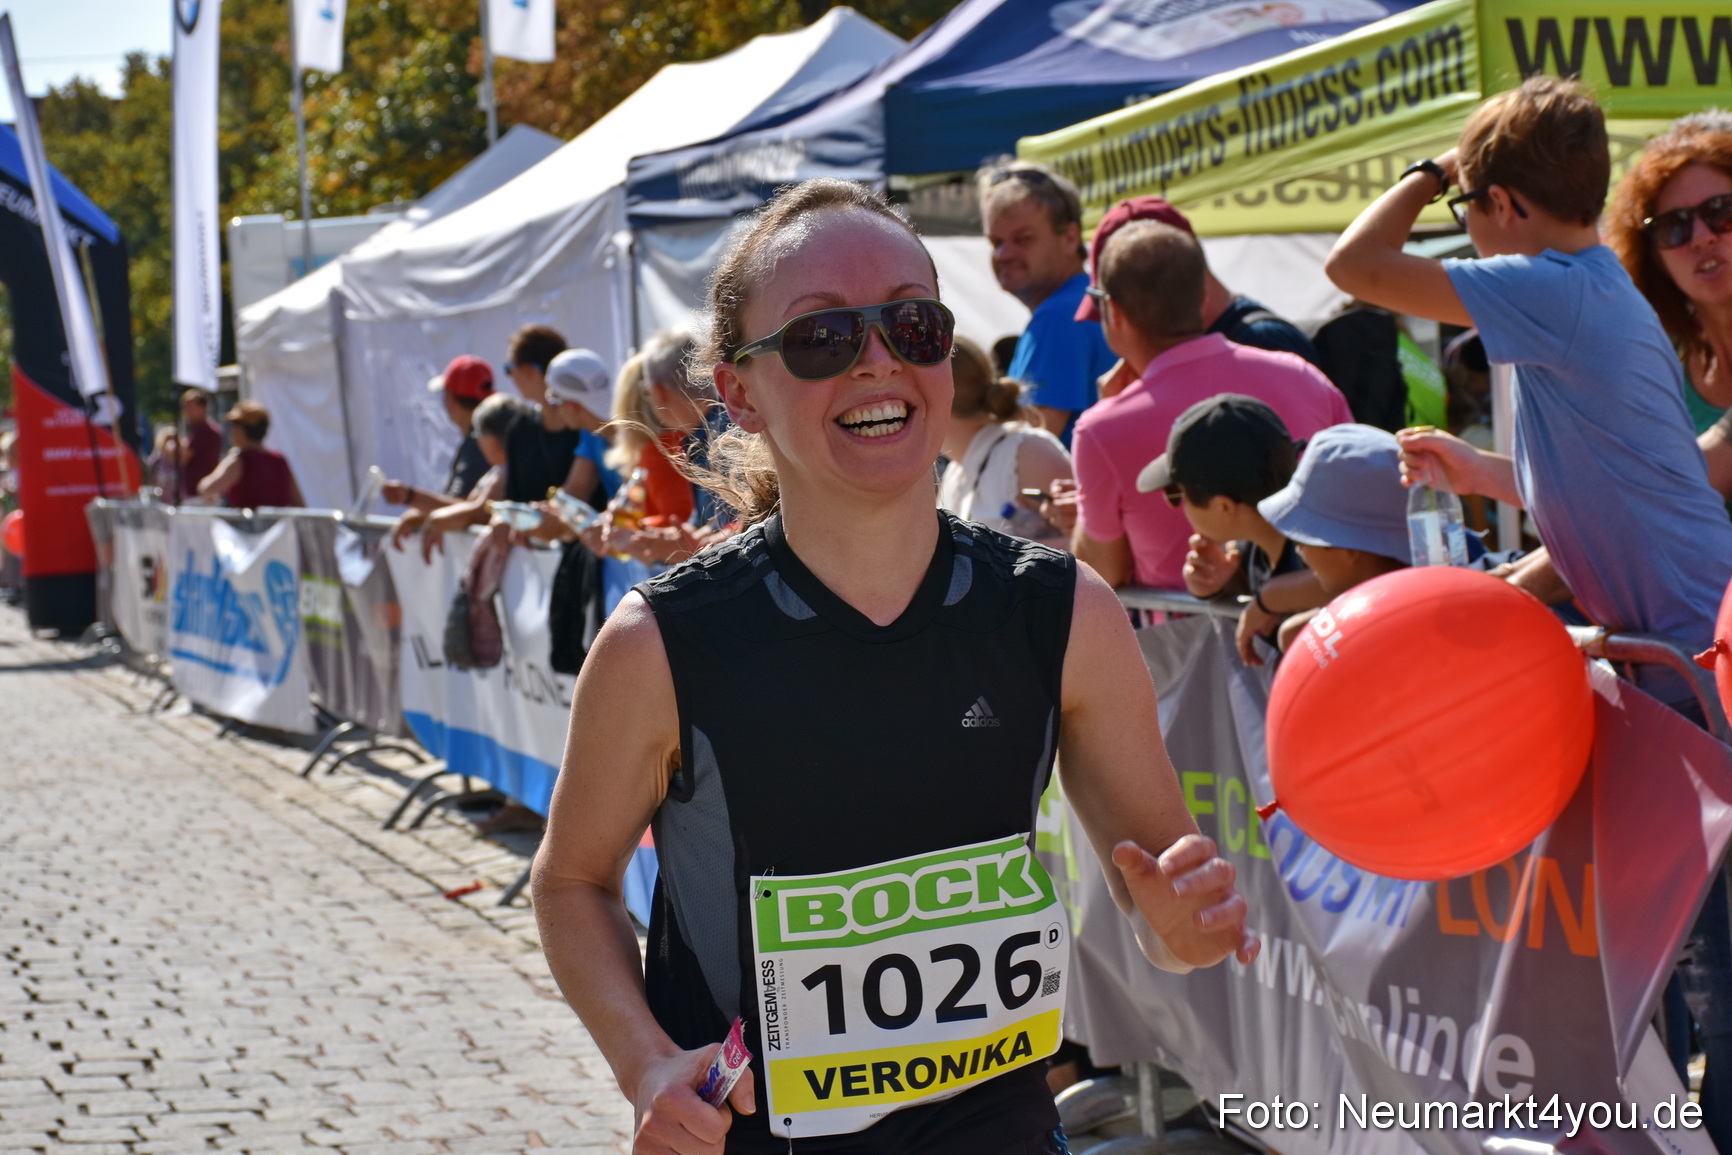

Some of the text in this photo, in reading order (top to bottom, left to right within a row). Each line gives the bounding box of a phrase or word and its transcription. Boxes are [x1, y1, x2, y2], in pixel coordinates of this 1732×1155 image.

[1053, 24, 1467, 213] ww.jumpers-fitness.com
[962, 716, 1000, 727] adidas
[780, 849, 1041, 938] BOCK
[801, 931, 1041, 1036] 1026
[782, 1004, 790, 1049] TRANSPONDER
[803, 1031, 1033, 1100] VERONIKA
